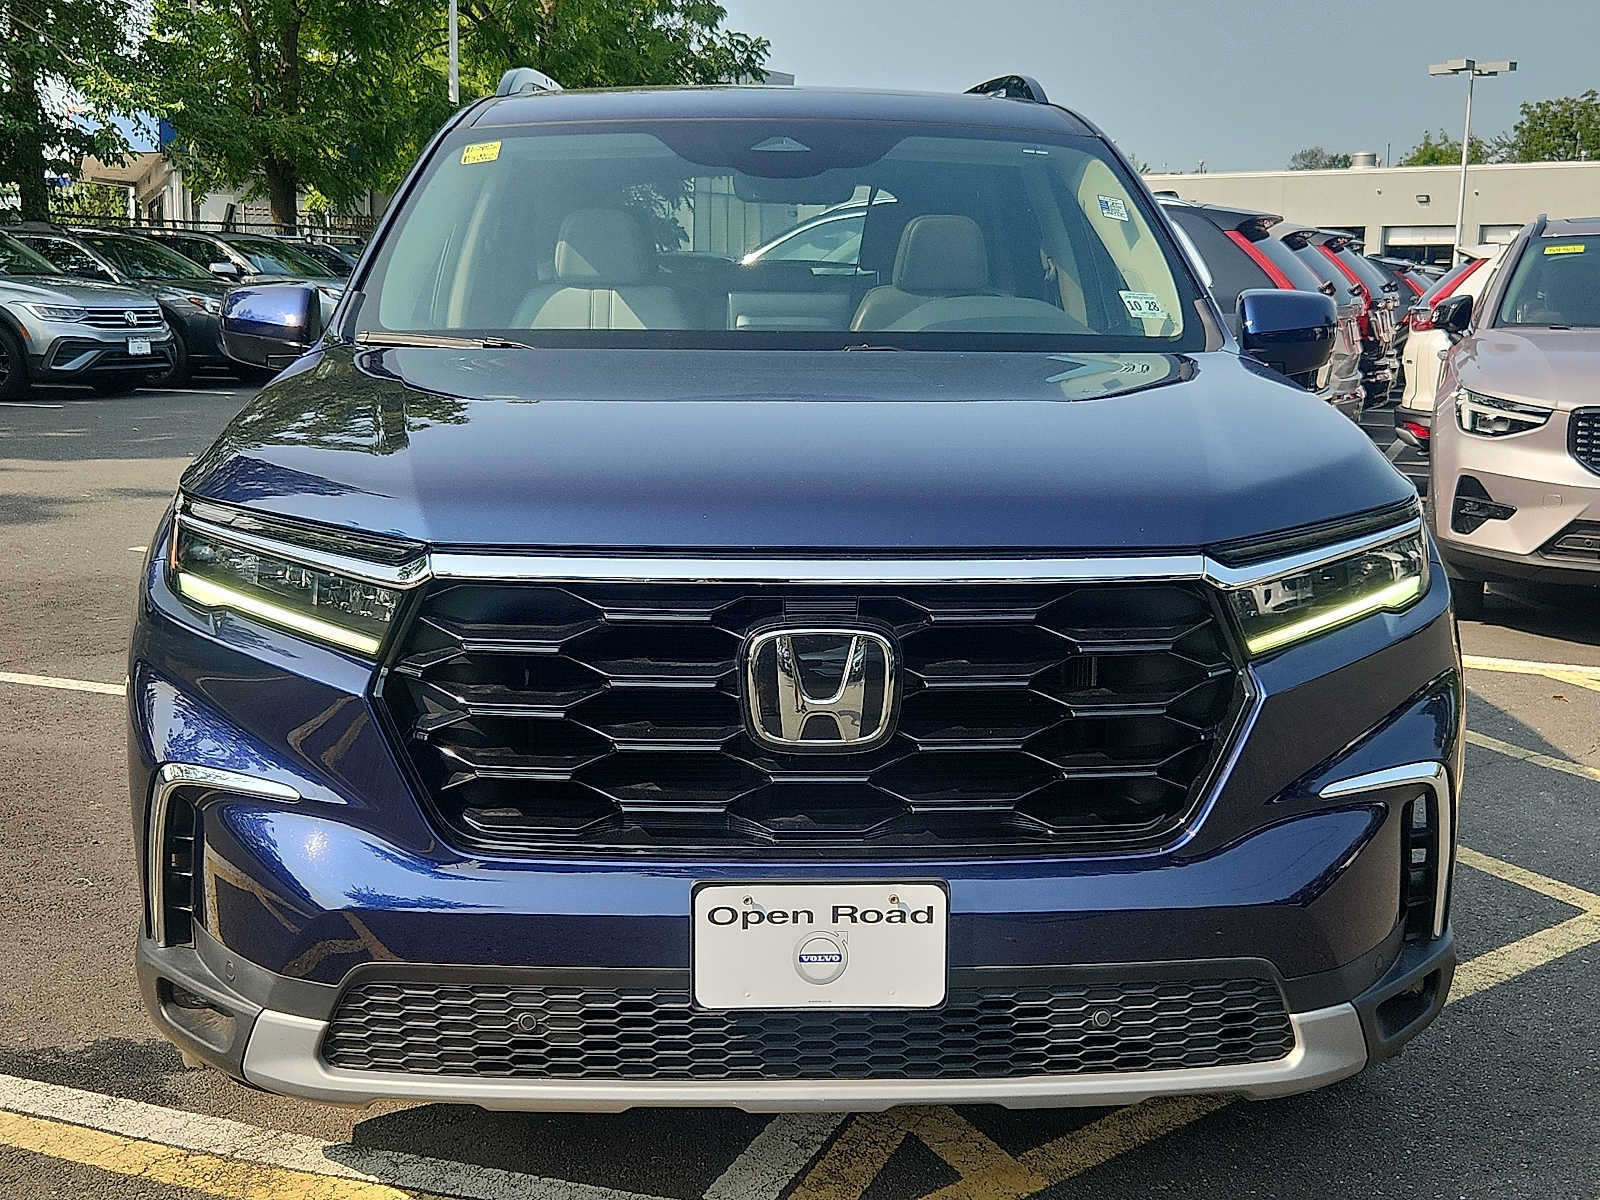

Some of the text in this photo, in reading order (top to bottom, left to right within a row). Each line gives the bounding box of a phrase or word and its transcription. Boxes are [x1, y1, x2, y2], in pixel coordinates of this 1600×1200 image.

[1127, 300, 1160, 312] 10 28
[708, 905, 934, 930] Open Road
[800, 954, 841, 962] VOLVO
